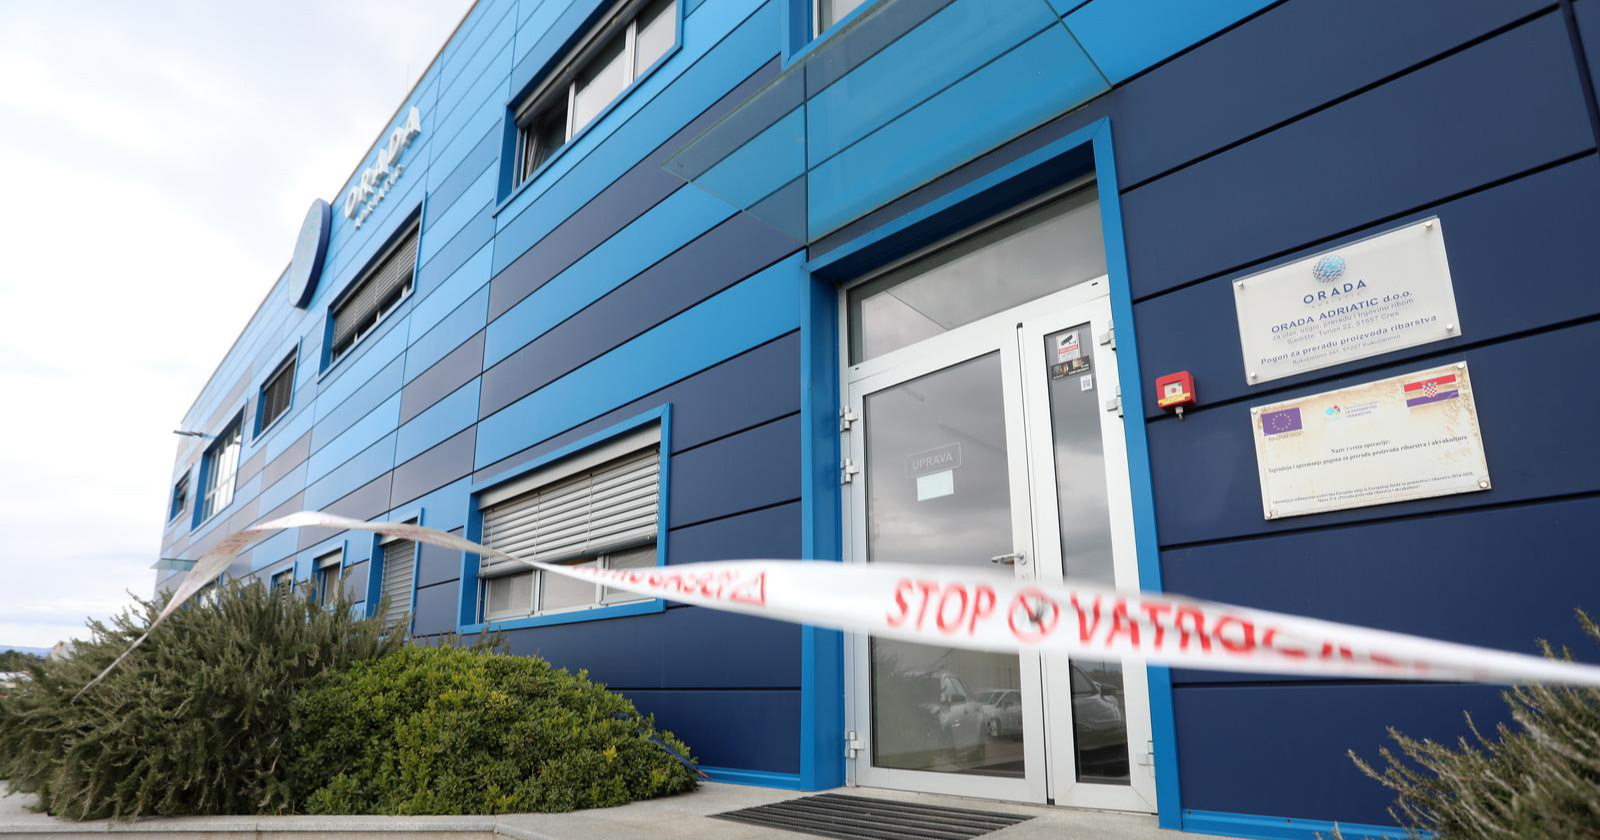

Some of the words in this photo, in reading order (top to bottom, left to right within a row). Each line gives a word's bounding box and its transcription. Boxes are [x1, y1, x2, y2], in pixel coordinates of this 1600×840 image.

[344, 105, 421, 220] ORADA
[1271, 316, 1315, 333] ORADA
[1319, 298, 1378, 321] ADRIATIC
[1383, 291, 1412, 303] d.o.o.
[1303, 279, 1366, 304] ORADA
[1323, 314, 1352, 329] preradu
[1358, 304, 1389, 318] trgovinu
[1391, 298, 1414, 309] ribom
[1261, 353, 1289, 365] Pogon
[1302, 340, 1338, 355] preradu
[1341, 328, 1388, 346] proizvoda
[1391, 315, 1437, 332] ribarstva
[913, 451, 953, 470] UPRAVA
[887, 579, 996, 637] STOP
